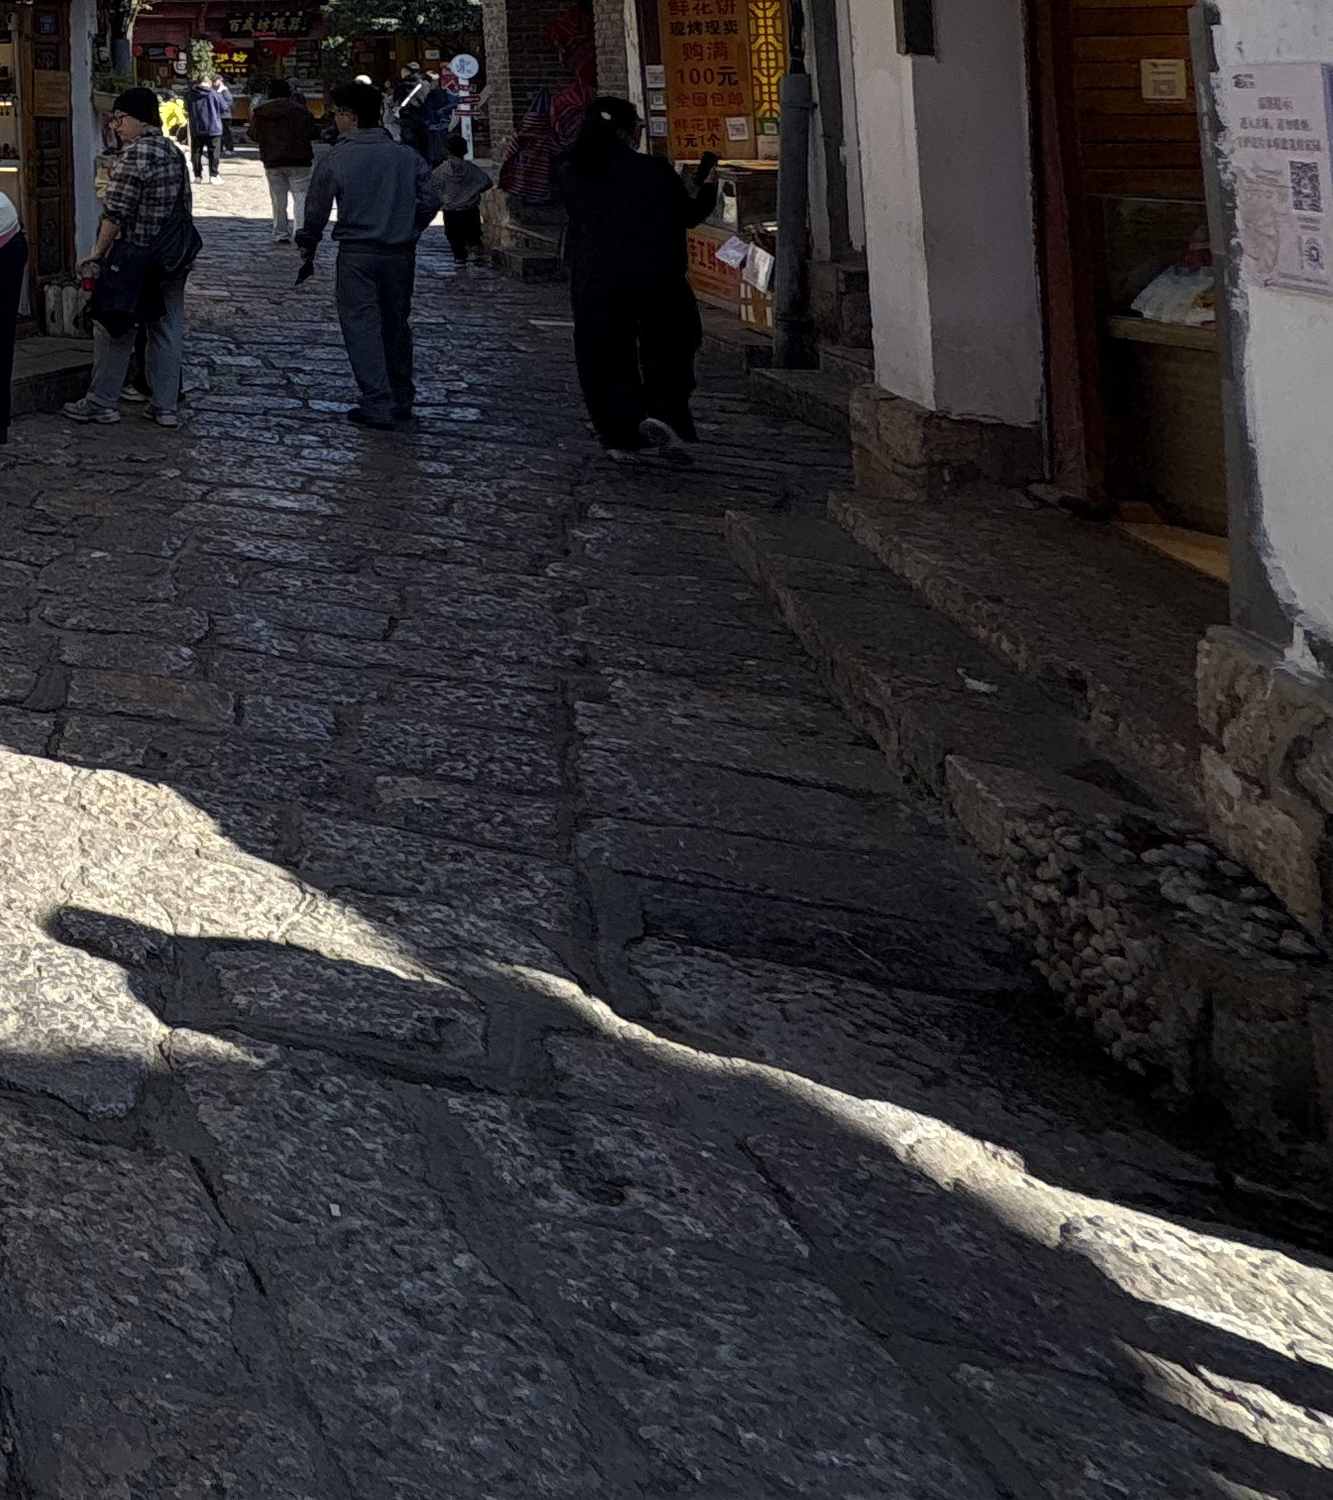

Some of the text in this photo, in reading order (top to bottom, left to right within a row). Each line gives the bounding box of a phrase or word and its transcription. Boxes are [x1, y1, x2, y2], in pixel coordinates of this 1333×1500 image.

[669, 19, 739, 37] 现烤现卖
[682, 41, 730, 62] 购满
[675, 66, 739, 87] 100元
[675, 91, 744, 109] 全国包邮
[674, 118, 722, 133] 鲜花饼
[676, 133, 721, 149] 1元1个
